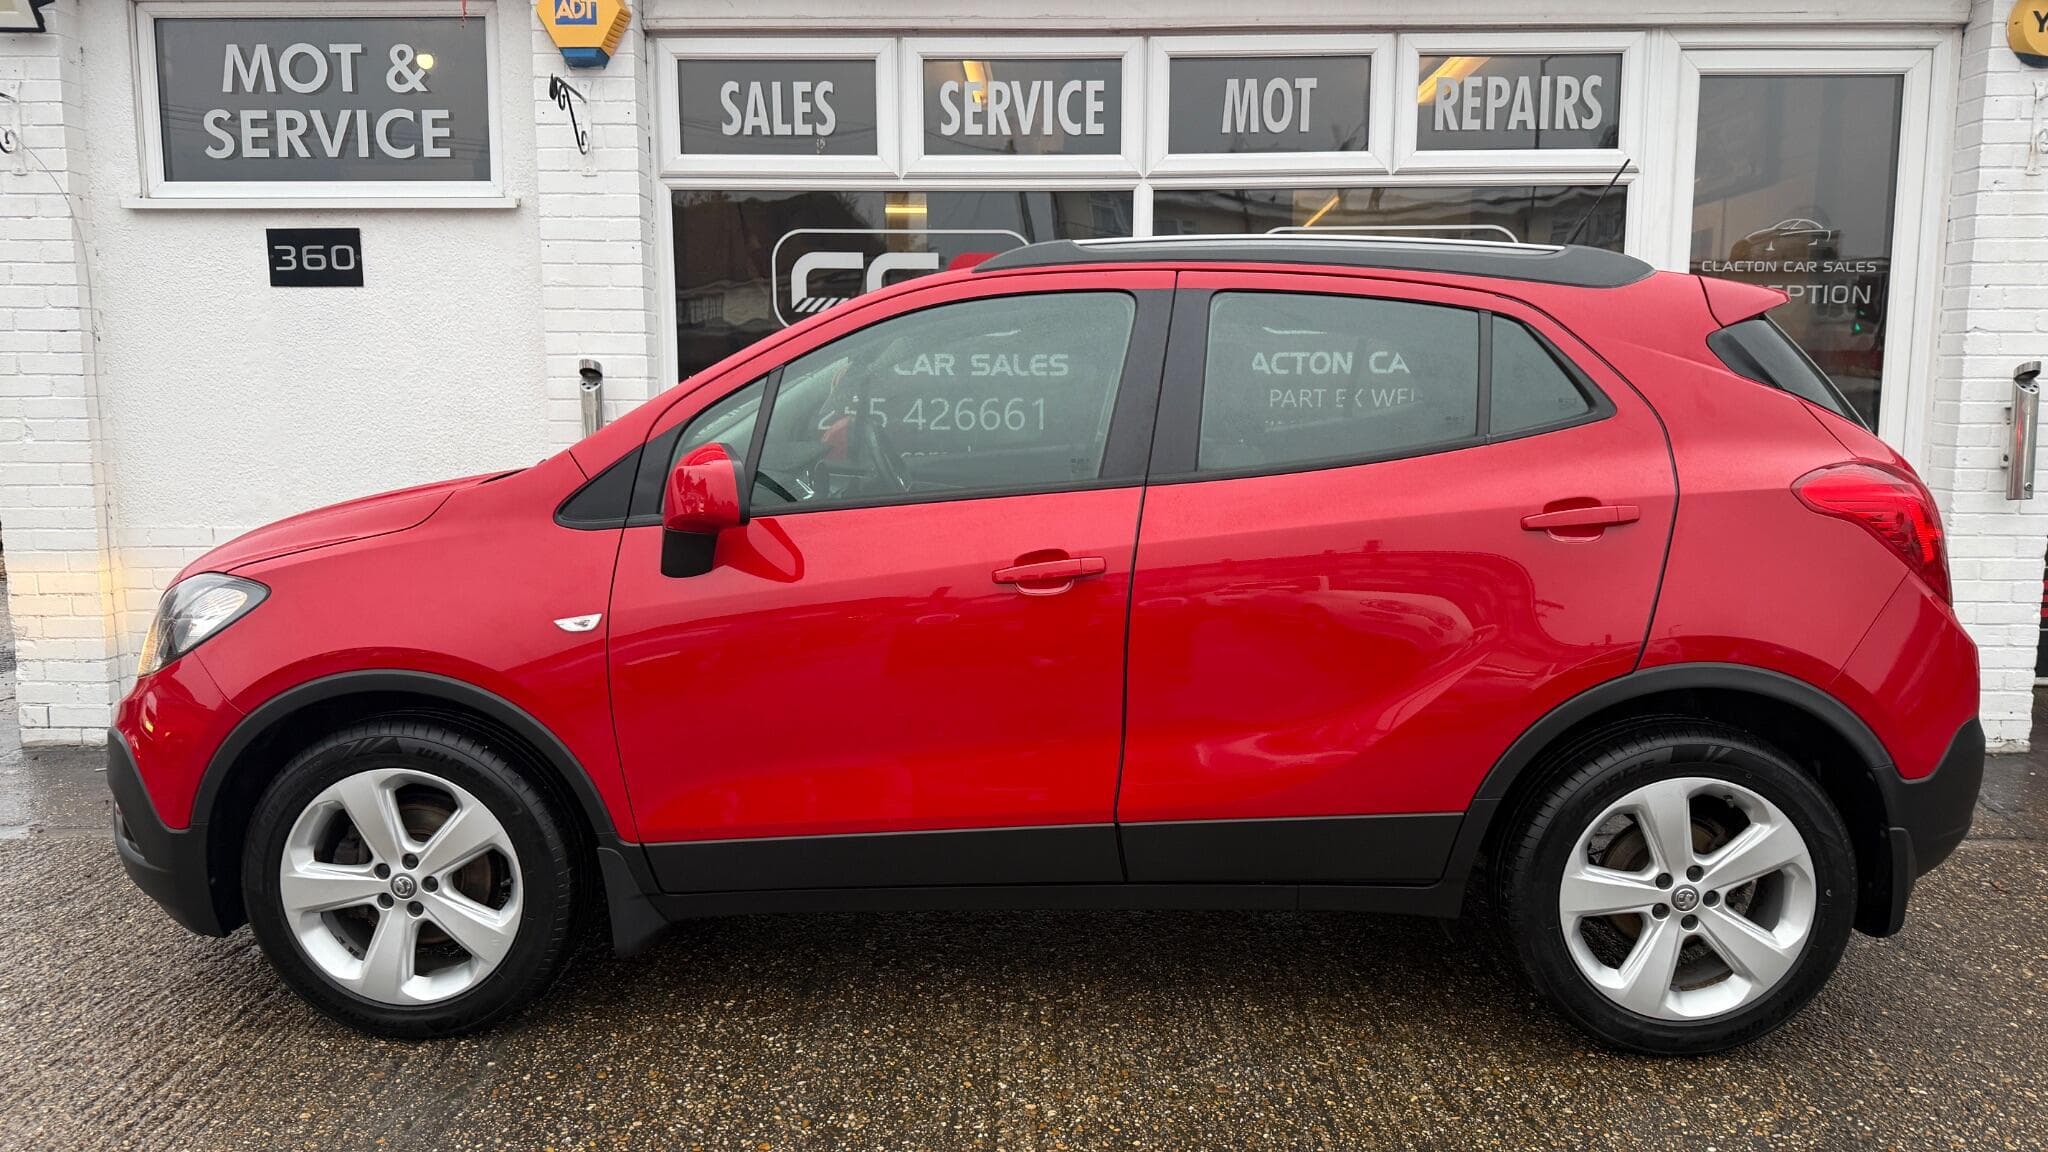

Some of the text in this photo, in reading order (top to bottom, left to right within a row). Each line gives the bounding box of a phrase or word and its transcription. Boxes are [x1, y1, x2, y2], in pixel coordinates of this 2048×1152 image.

[555, 0, 596, 19] ADT
[222, 43, 428, 93] MOT &
[720, 80, 836, 136] SALES
[940, 80, 1105, 136] SERVICE
[1221, 77, 1317, 134] MOT
[1434, 74, 1603, 131] REPAIRS
[203, 108, 453, 159] SERVICE
[274, 245, 356, 271] 360
[1702, 260, 1877, 272] CLACTON CAR SALES
[1768, 285, 1871, 304] PTION
[970, 353, 1069, 377] SALES
[1251, 351, 1353, 375] ACTON
[1269, 388, 1327, 408] PART
[902, 397, 1045, 431] 426661
